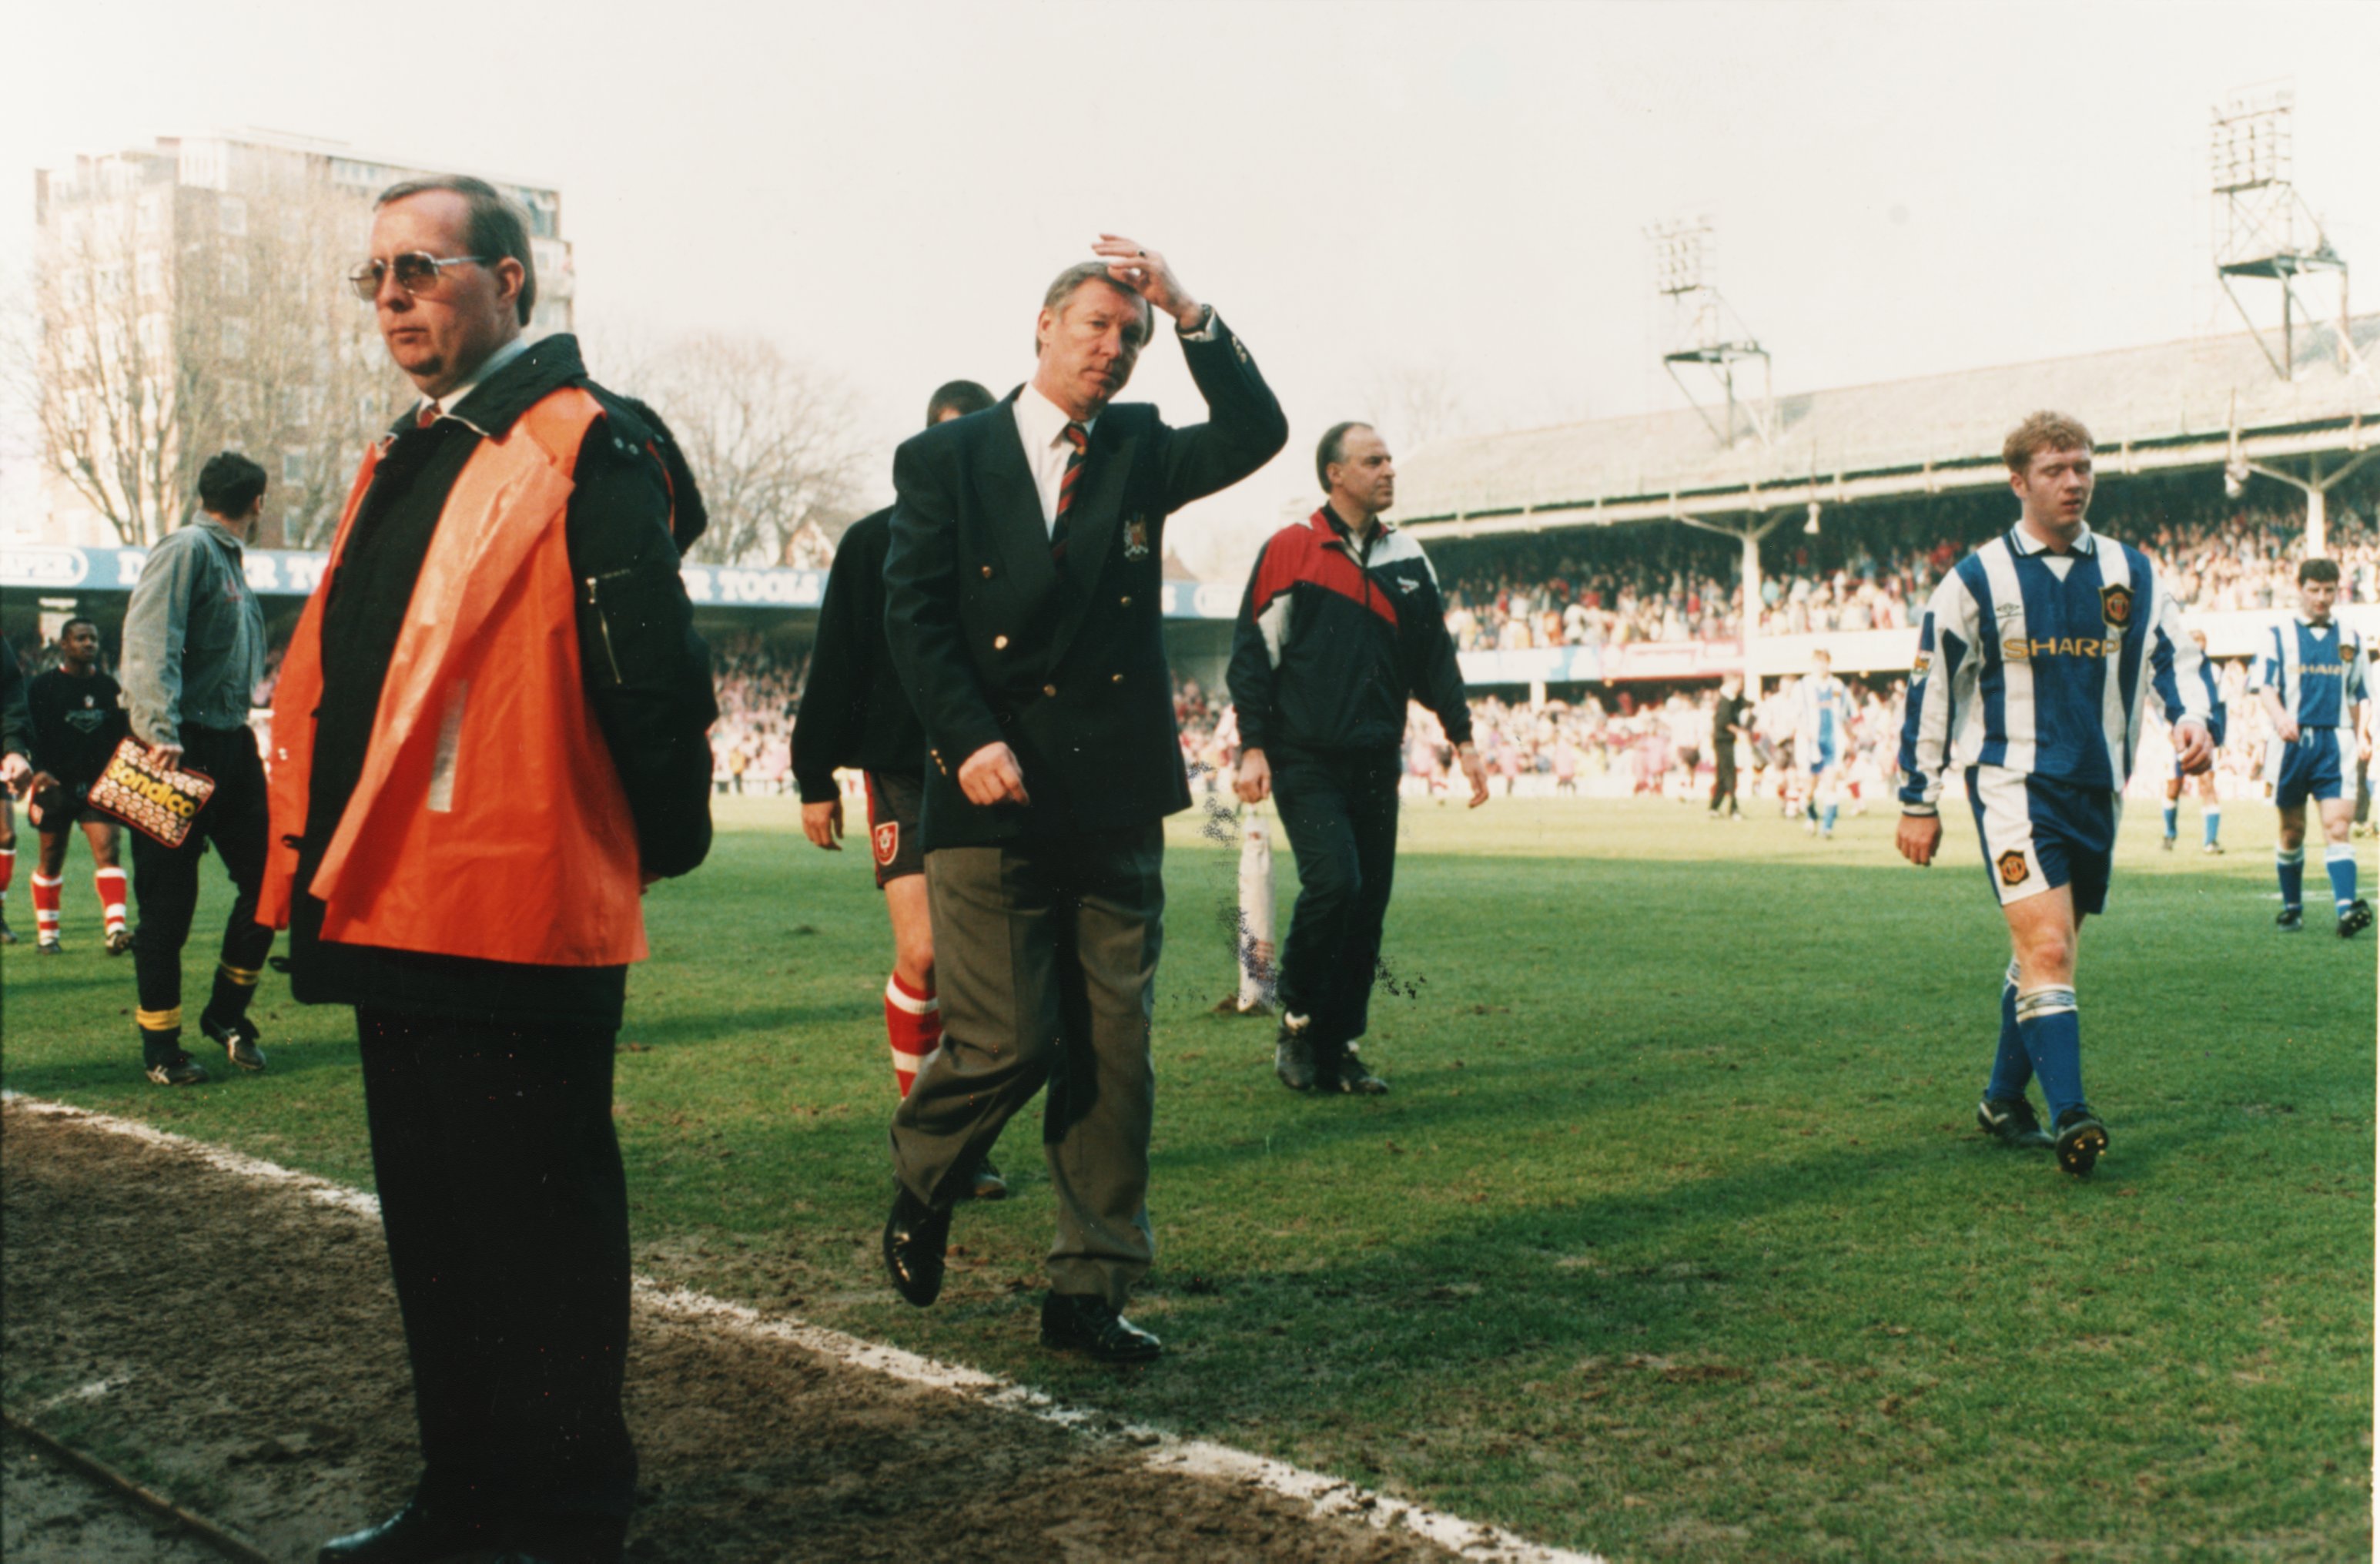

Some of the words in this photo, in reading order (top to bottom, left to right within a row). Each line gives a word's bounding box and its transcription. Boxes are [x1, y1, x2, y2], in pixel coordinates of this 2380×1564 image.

[0, 553, 74, 578] APER
[718, 569, 819, 603] TOOLS
[2004, 638, 2120, 659] SHARP
[107, 758, 195, 818] sondico
